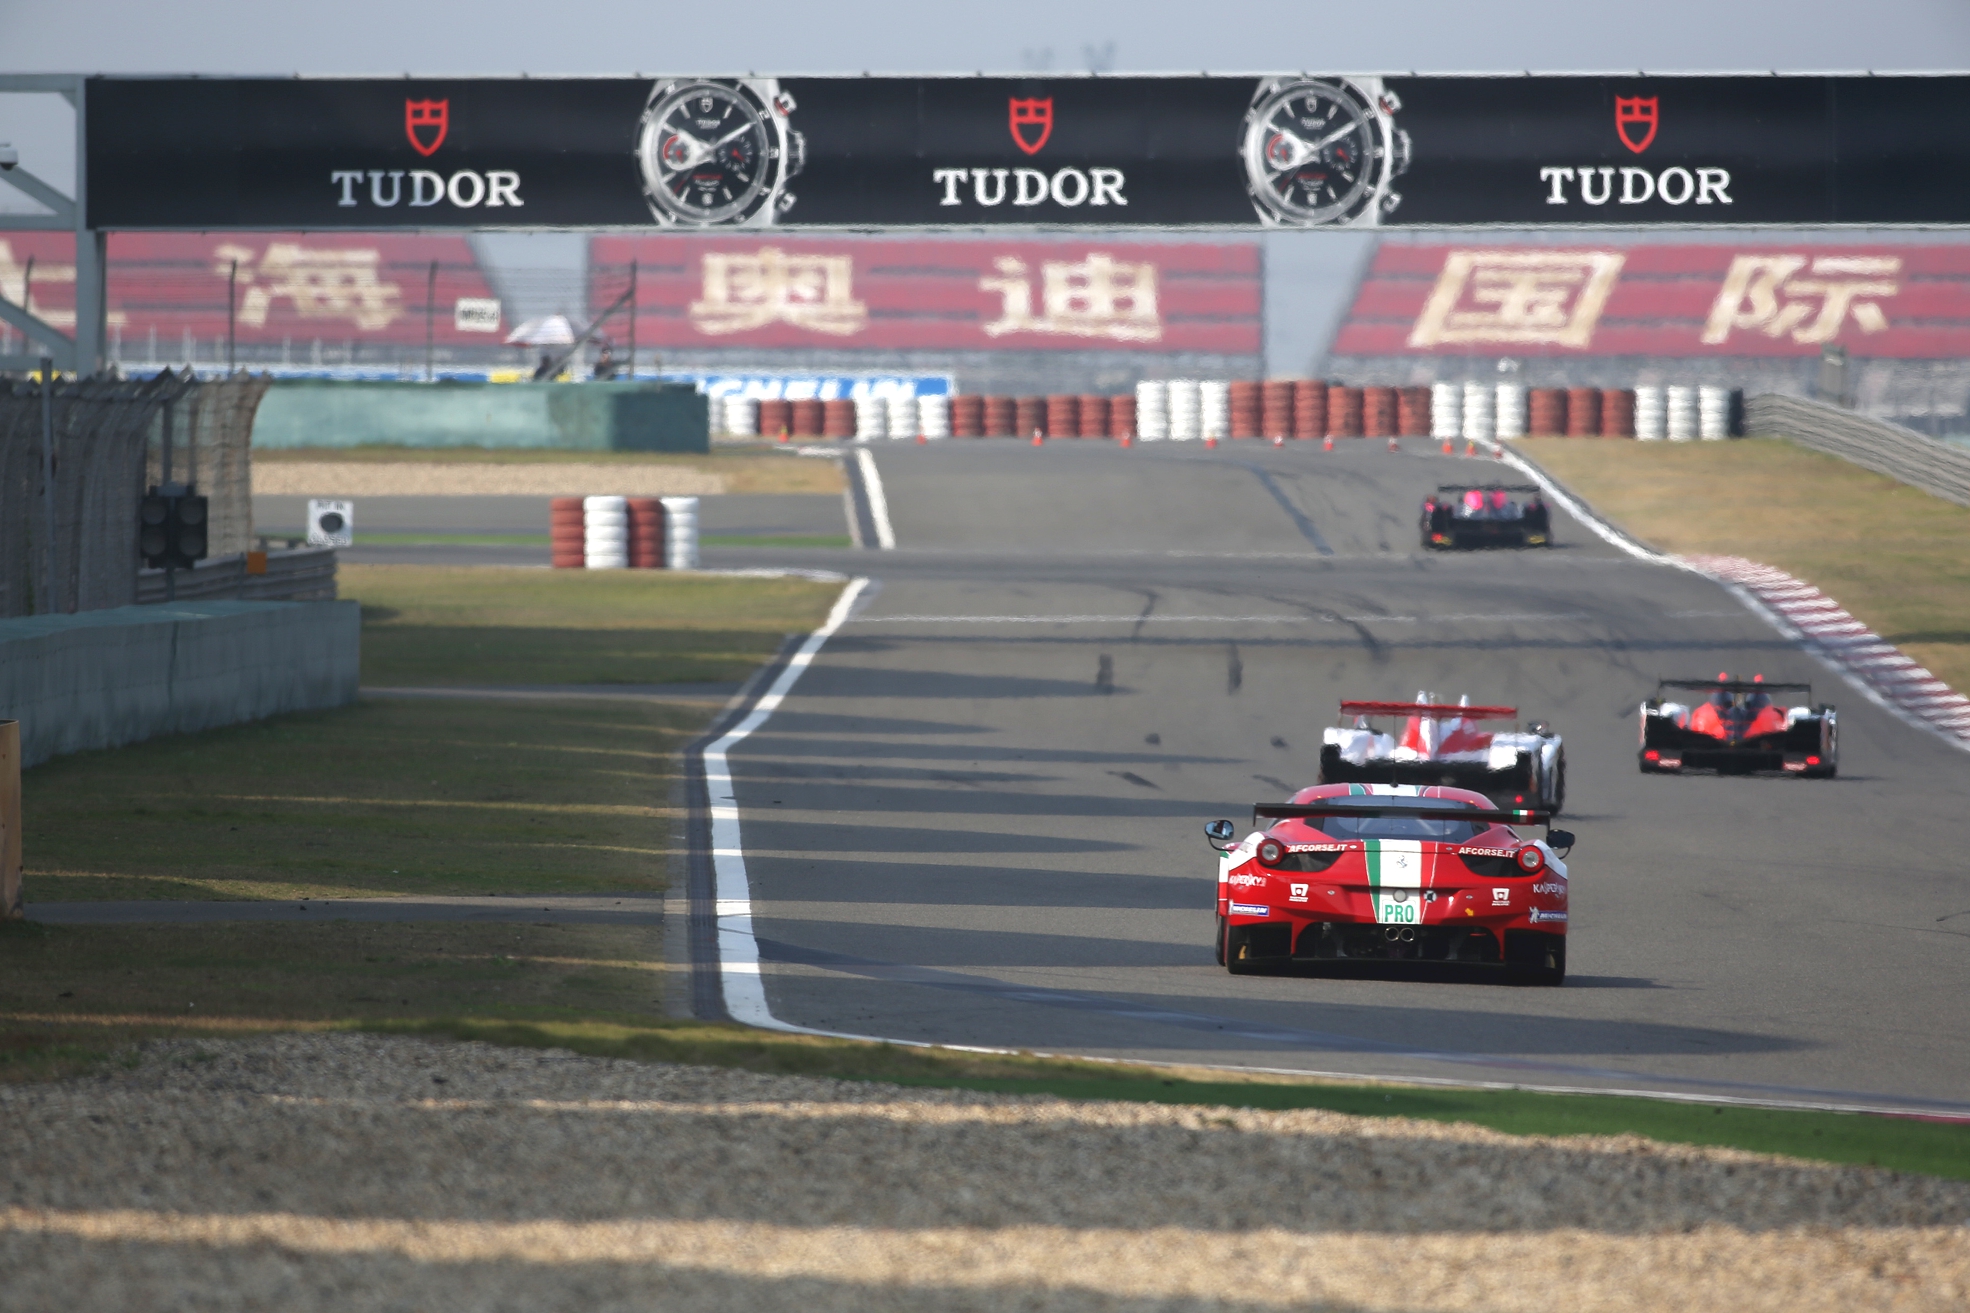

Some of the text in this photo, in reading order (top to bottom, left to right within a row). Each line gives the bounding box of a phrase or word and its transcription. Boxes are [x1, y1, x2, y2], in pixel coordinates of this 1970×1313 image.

[331, 169, 525, 209] TUDOR
[933, 166, 1129, 208] TUDOR
[1539, 166, 1734, 206] TUDOR
[1458, 846, 1516, 858] AFCORSE.IT
[1384, 904, 1415, 923] PRO
